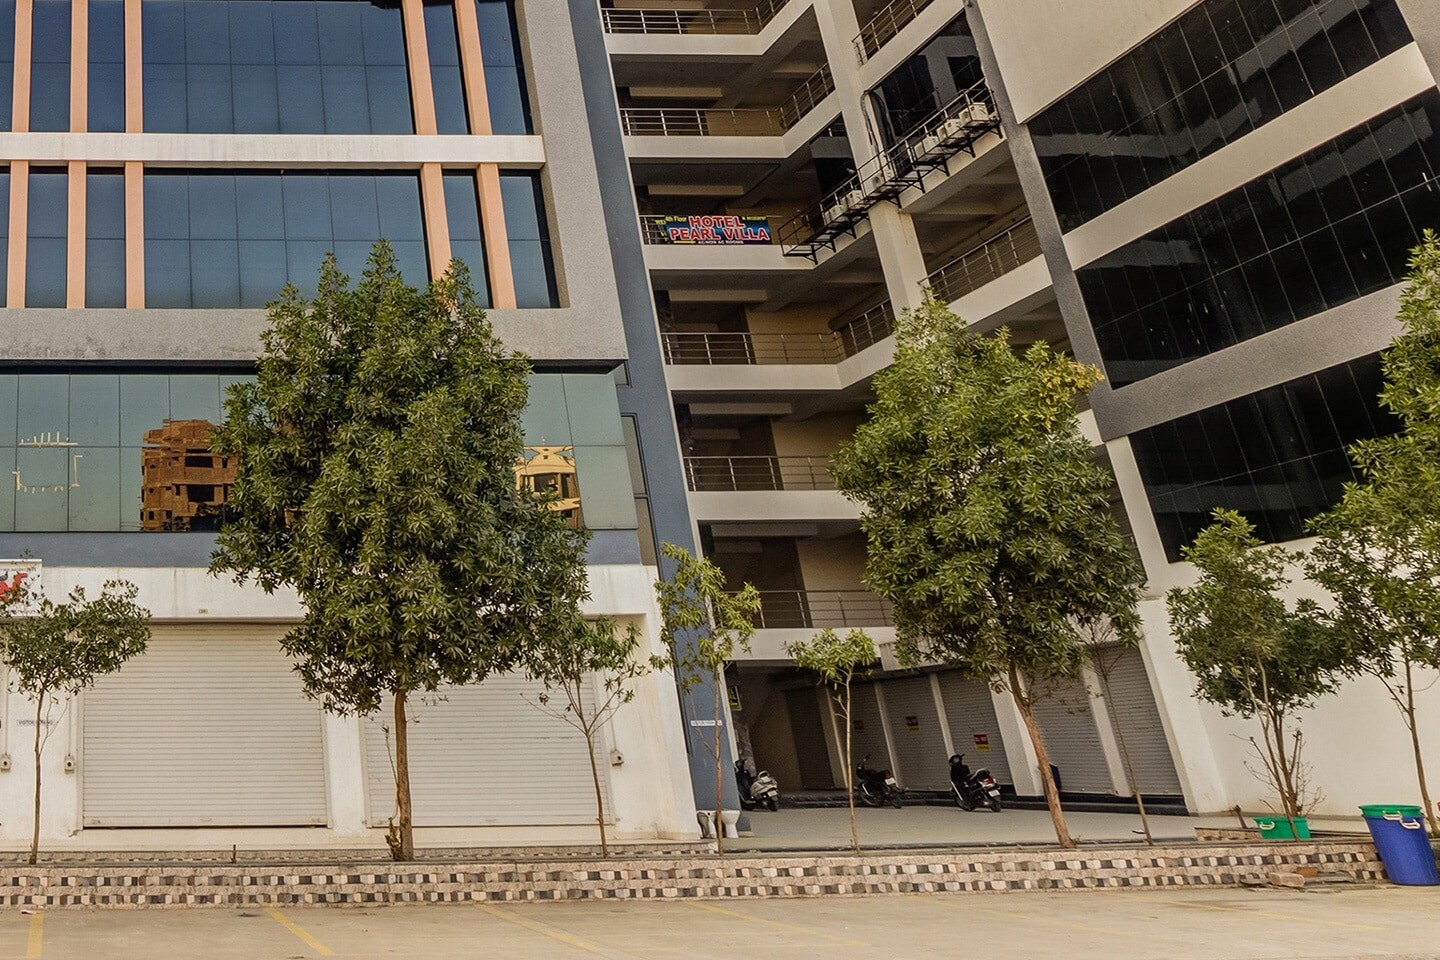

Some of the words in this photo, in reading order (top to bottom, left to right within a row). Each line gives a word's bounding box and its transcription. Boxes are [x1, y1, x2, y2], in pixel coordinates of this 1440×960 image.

[688, 215, 745, 228] HOTEL
[668, 228, 721, 241] PEARL
[722, 228, 770, 241] VILLA
